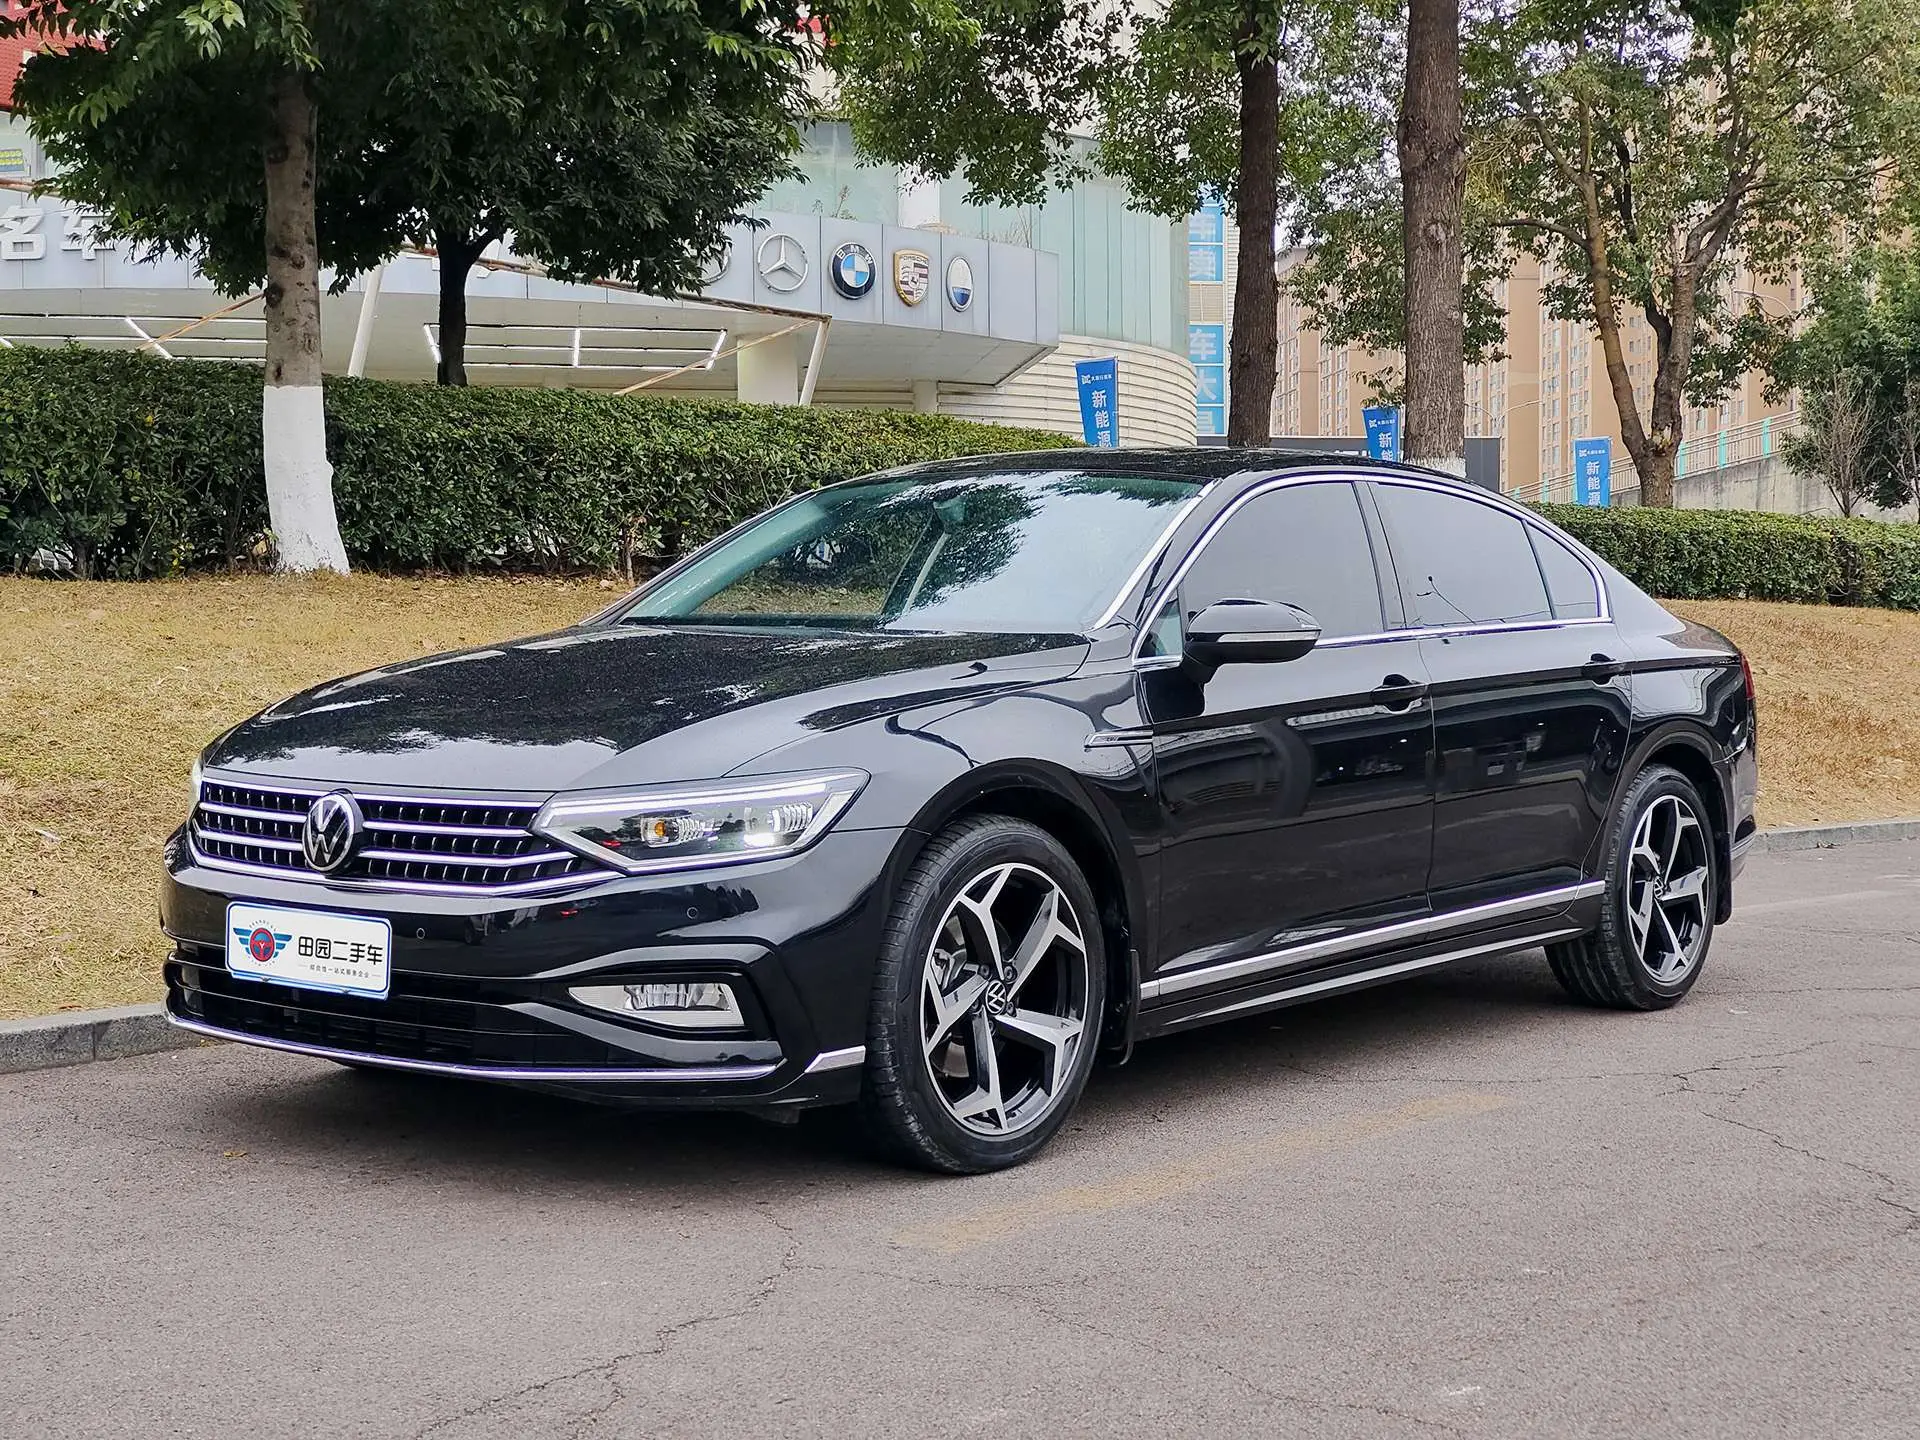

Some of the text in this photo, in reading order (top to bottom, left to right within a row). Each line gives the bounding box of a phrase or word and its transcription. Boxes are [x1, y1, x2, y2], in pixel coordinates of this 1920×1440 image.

[1091, 389, 1112, 448] 新能源
[1586, 460, 1600, 506] 新能源
[298, 935, 383, 966] 田园二手车
